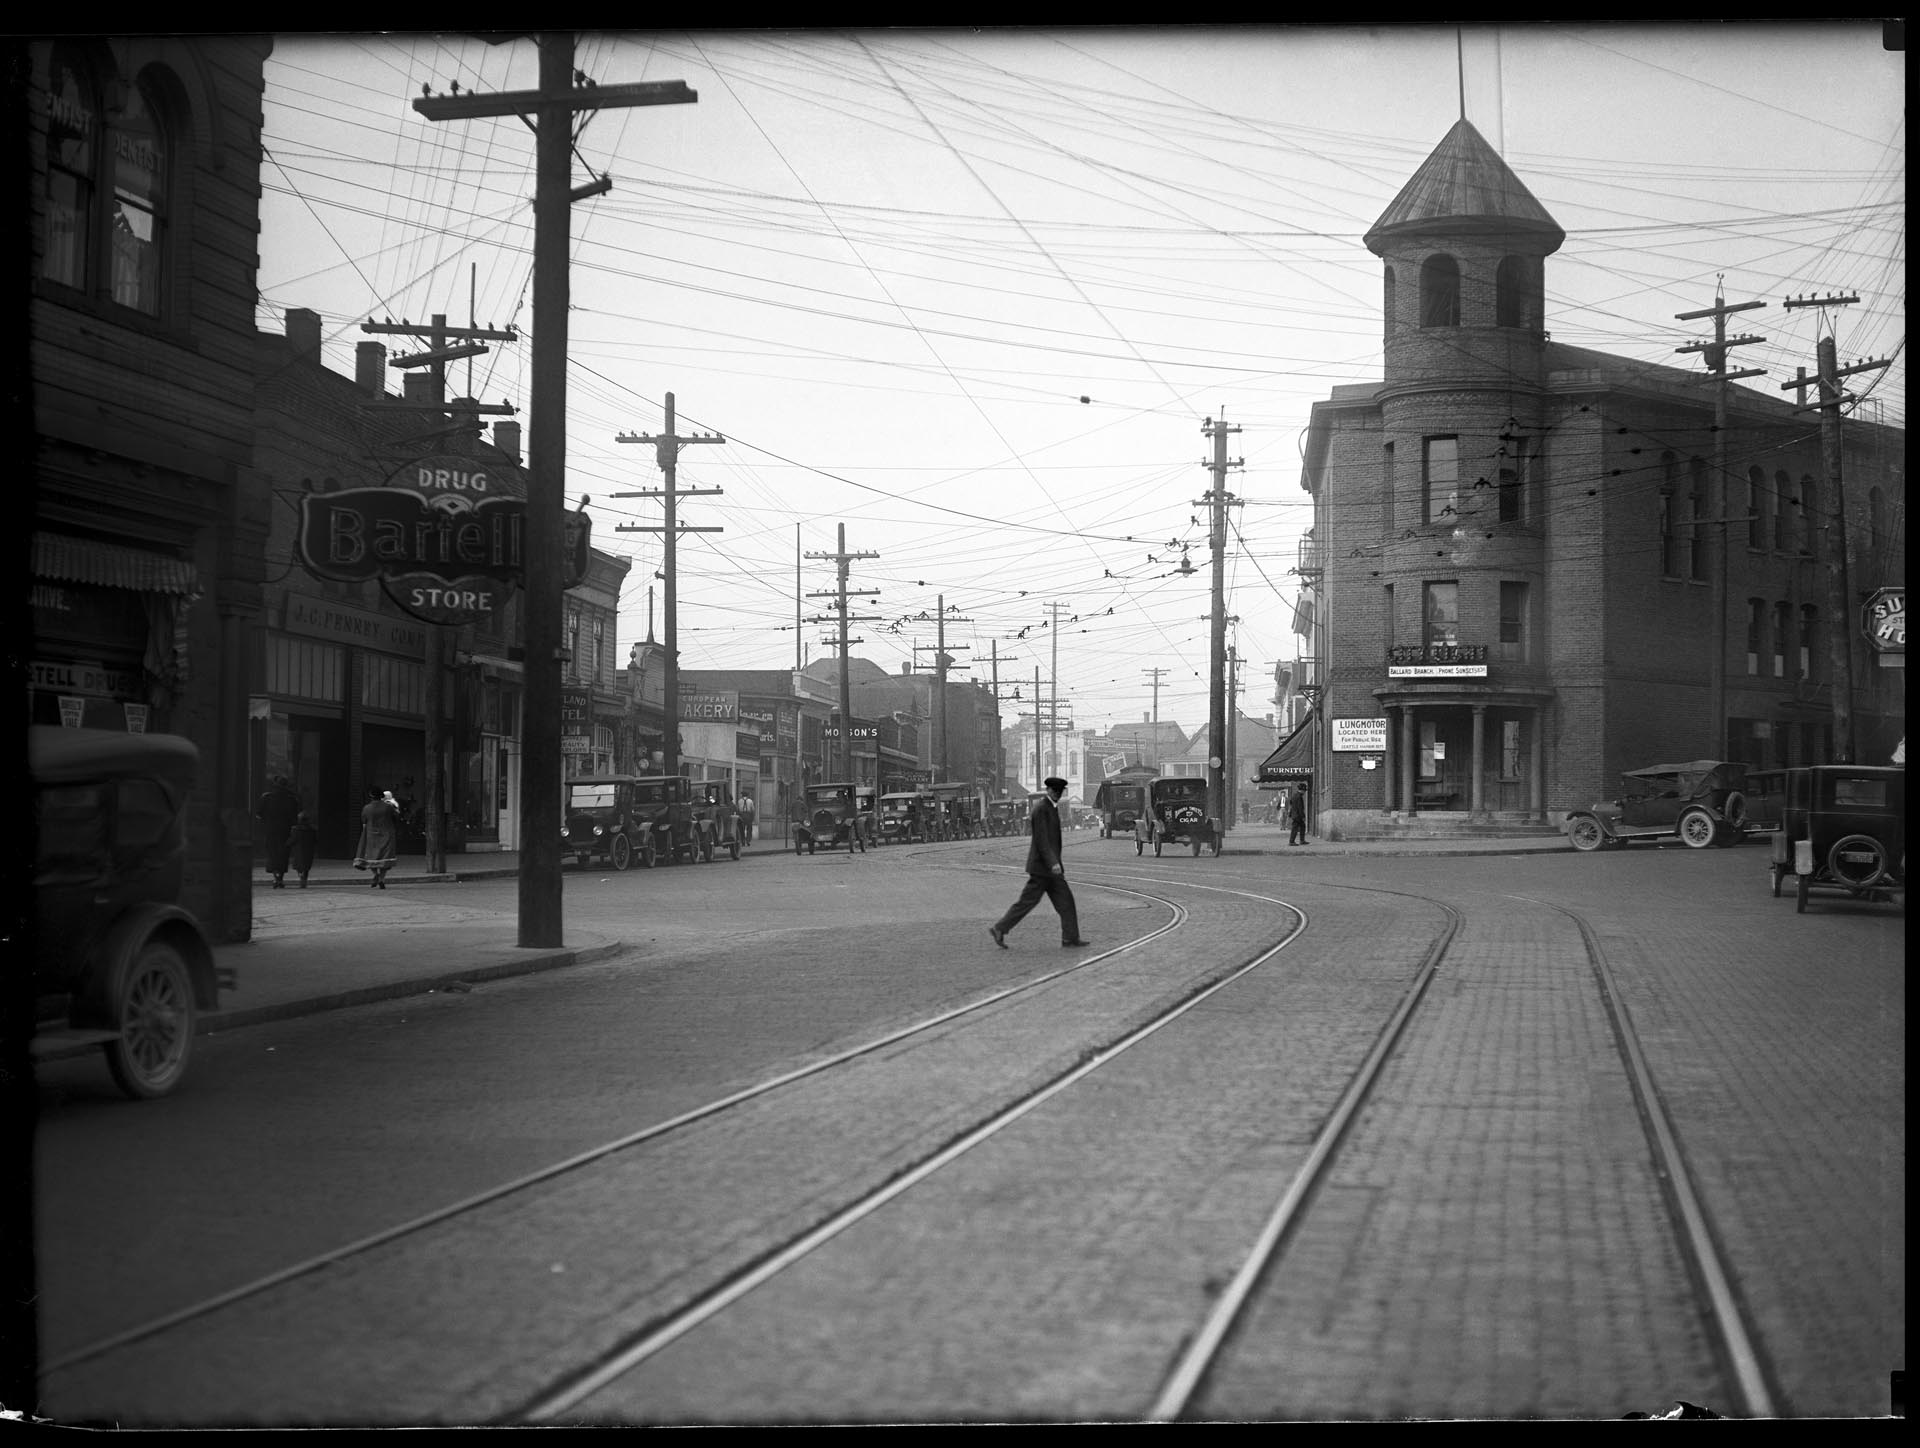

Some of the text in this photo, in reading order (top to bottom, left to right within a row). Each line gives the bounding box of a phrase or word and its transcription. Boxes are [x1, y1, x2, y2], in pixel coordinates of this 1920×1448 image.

[45, 92, 93, 134] ENTIST
[114, 132, 164, 174] DENTIST
[418, 468, 488, 491] DRUG
[329, 506, 521, 567] Bartell
[411, 588, 493, 611] STORE
[684, 704, 734, 720] AKERY
[825, 728, 878, 738] MOSON'S
[1340, 720, 1386, 729] LUNGMOTOR
